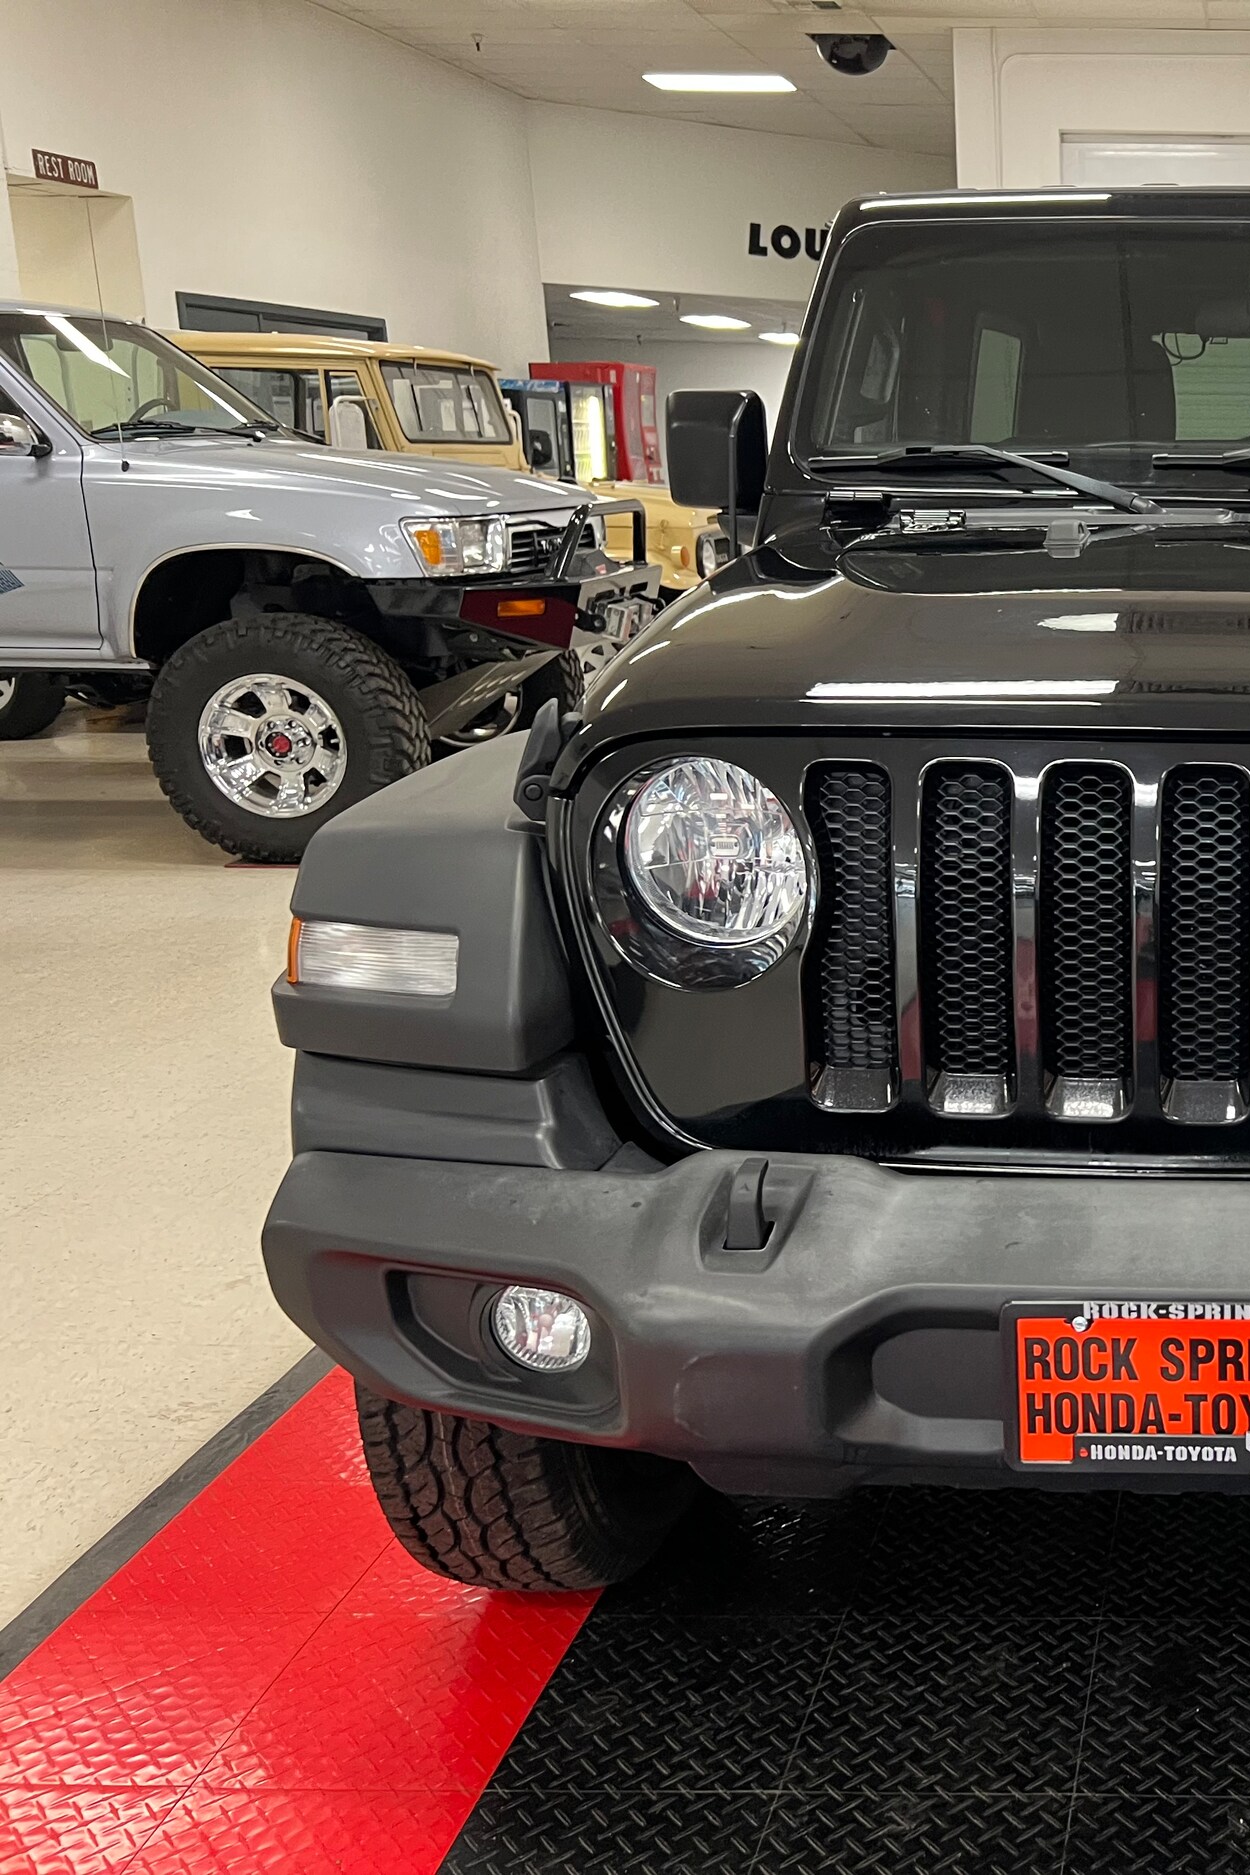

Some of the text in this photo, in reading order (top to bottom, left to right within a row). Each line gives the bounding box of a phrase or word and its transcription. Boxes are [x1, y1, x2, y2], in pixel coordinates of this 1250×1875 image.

[37, 153, 95, 185] REST ROOM
[1023, 1337, 1138, 1381] ROCK
[1090, 1444, 1237, 1463] HONDA-TOYOTA
